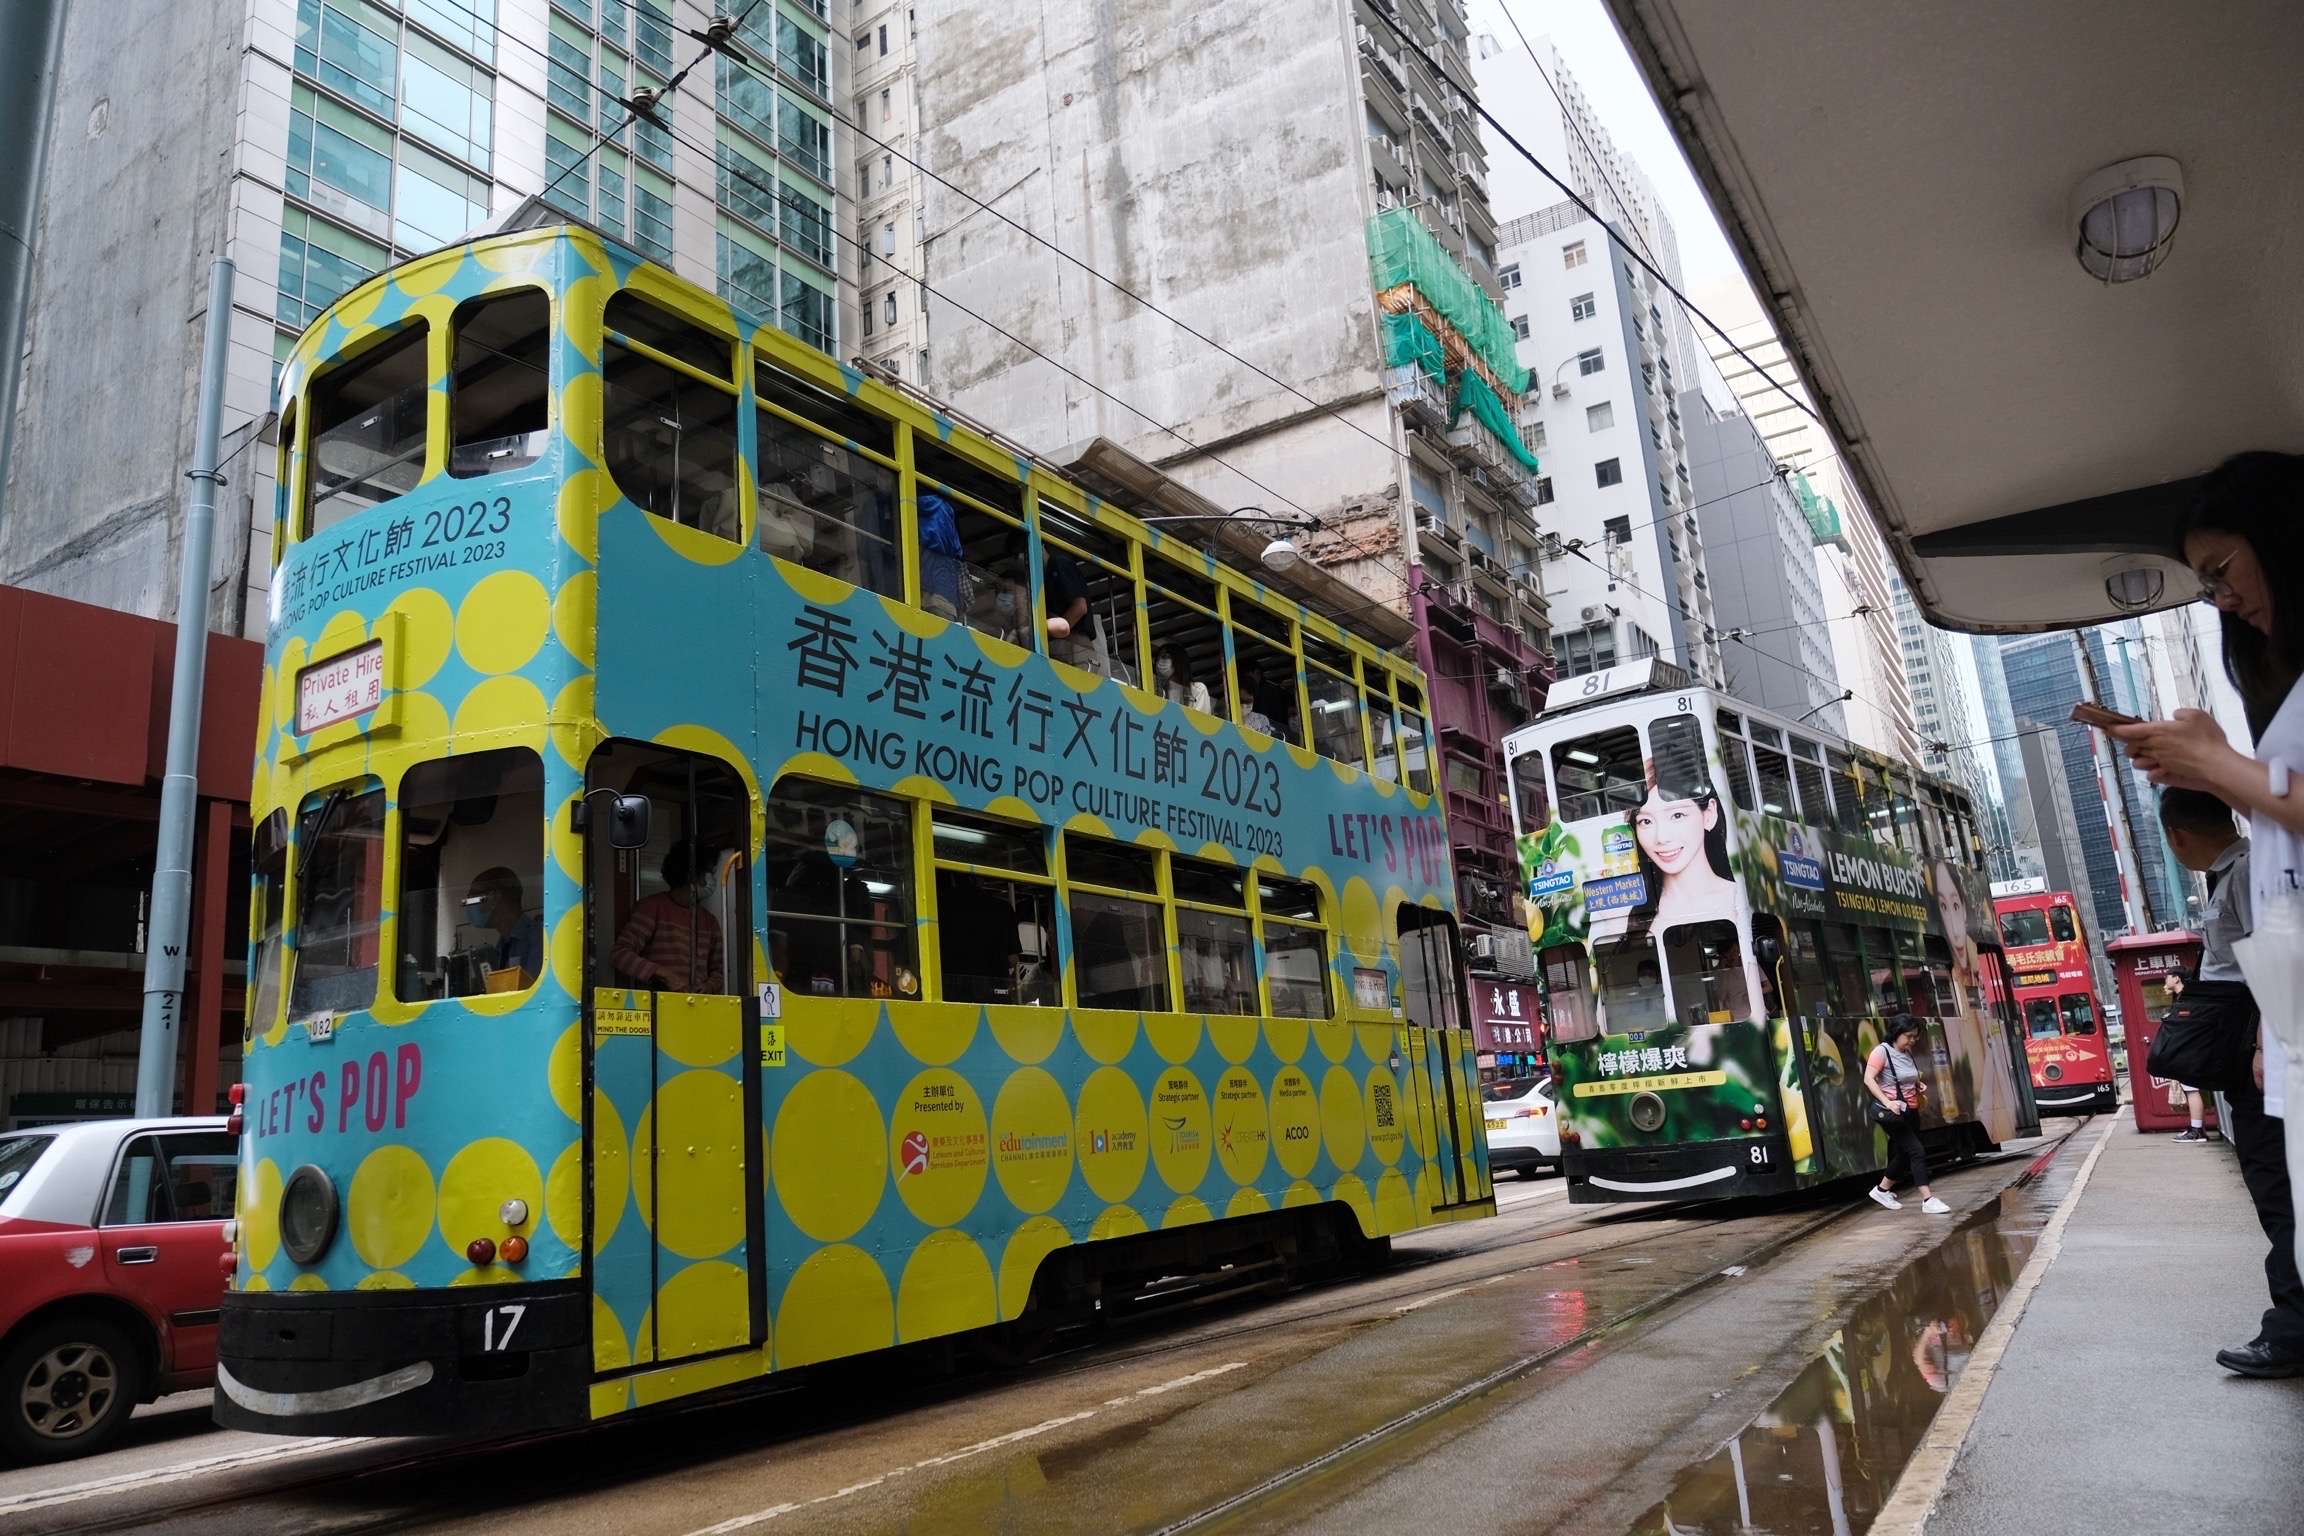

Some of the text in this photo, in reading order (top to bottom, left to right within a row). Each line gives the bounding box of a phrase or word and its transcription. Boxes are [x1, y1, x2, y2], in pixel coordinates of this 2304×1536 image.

[422, 496, 512, 548] 2023
[308, 592, 330, 616] POP
[333, 568, 385, 602] CULTURE
[390, 551, 457, 581] FESTIVAL
[462, 541, 505, 566] 2023
[303, 654, 382, 698] Private Hire
[1582, 672, 1610, 696] 81
[305, 679, 379, 727] 私人租用
[787, 605, 1282, 818] 香港流行文化節 2023
[1677, 697, 1693, 712] 81
[1508, 741, 1518, 755] 81
[796, 711, 1283, 858] HONG KONG POP CULTURE FESTIVAL 2023
[1328, 814, 1442, 888] LET'S POP
[1783, 859, 1820, 881] TSINGTAO
[1827, 851, 1922, 899] LEMON BURST
[1534, 875, 1571, 891] TSINGTAO
[1584, 878, 1641, 898] Western Market
[2004, 880, 2031, 893] 165
[1835, 891, 1877, 912] TSINGTAO
[1877, 900, 1903, 917] LEMON
[1911, 905, 1928, 921] BEER
[2054, 896, 2067, 904] 165
[163, 945, 180, 957] W
[2134, 953, 2181, 971] 上車點
[312, 1018, 331, 1037] 082
[597, 1026, 651, 1034] MIND THE DOORS
[1629, 1032, 1644, 1041] 003
[761, 1050, 784, 1061] EXIT
[1597, 1045, 1688, 1077] 檸檬爆爽
[259, 1043, 421, 1138] LET'S POP
[923, 1085, 955, 1098] 主辦單位
[2097, 1084, 2110, 1093] 165
[914, 1101, 965, 1112] Presented by
[1158, 1093, 1200, 1104] Strategic partner
[1000, 1132, 1068, 1152] edutainment
[1285, 1126, 1309, 1141] ACOO
[1750, 1145, 1768, 1163] 81
[484, 1305, 526, 1351] 17
